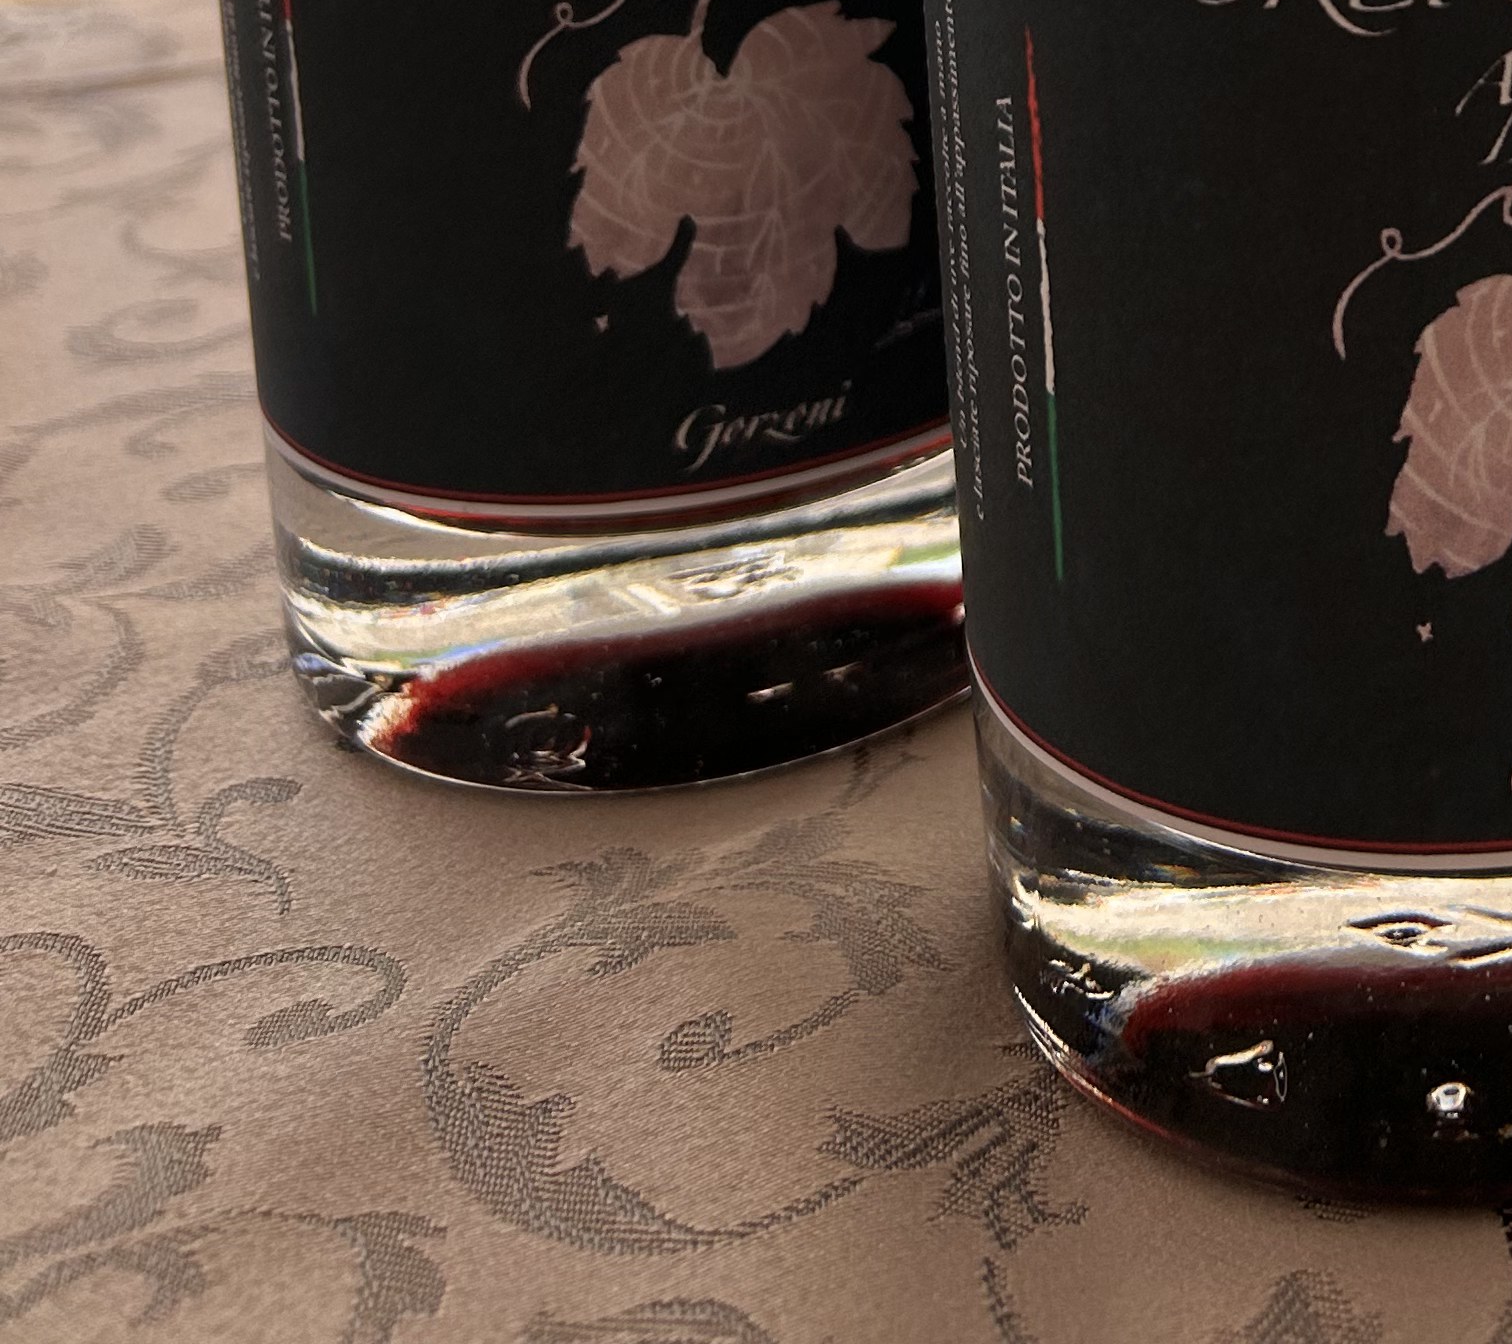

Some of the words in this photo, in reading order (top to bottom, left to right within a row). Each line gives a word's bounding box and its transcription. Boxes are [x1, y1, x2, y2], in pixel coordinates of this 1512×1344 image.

[934, 20, 946, 99] mano
[996, 96, 1020, 220] ITALIA
[1002, 223, 1022, 266] IN
[963, 283, 980, 394] riposare
[1006, 273, 1034, 489] PRODOTTO
[672, 378, 853, 477] Gorzoni
[970, 400, 984, 499] lasciate
[975, 503, 985, 521] e
